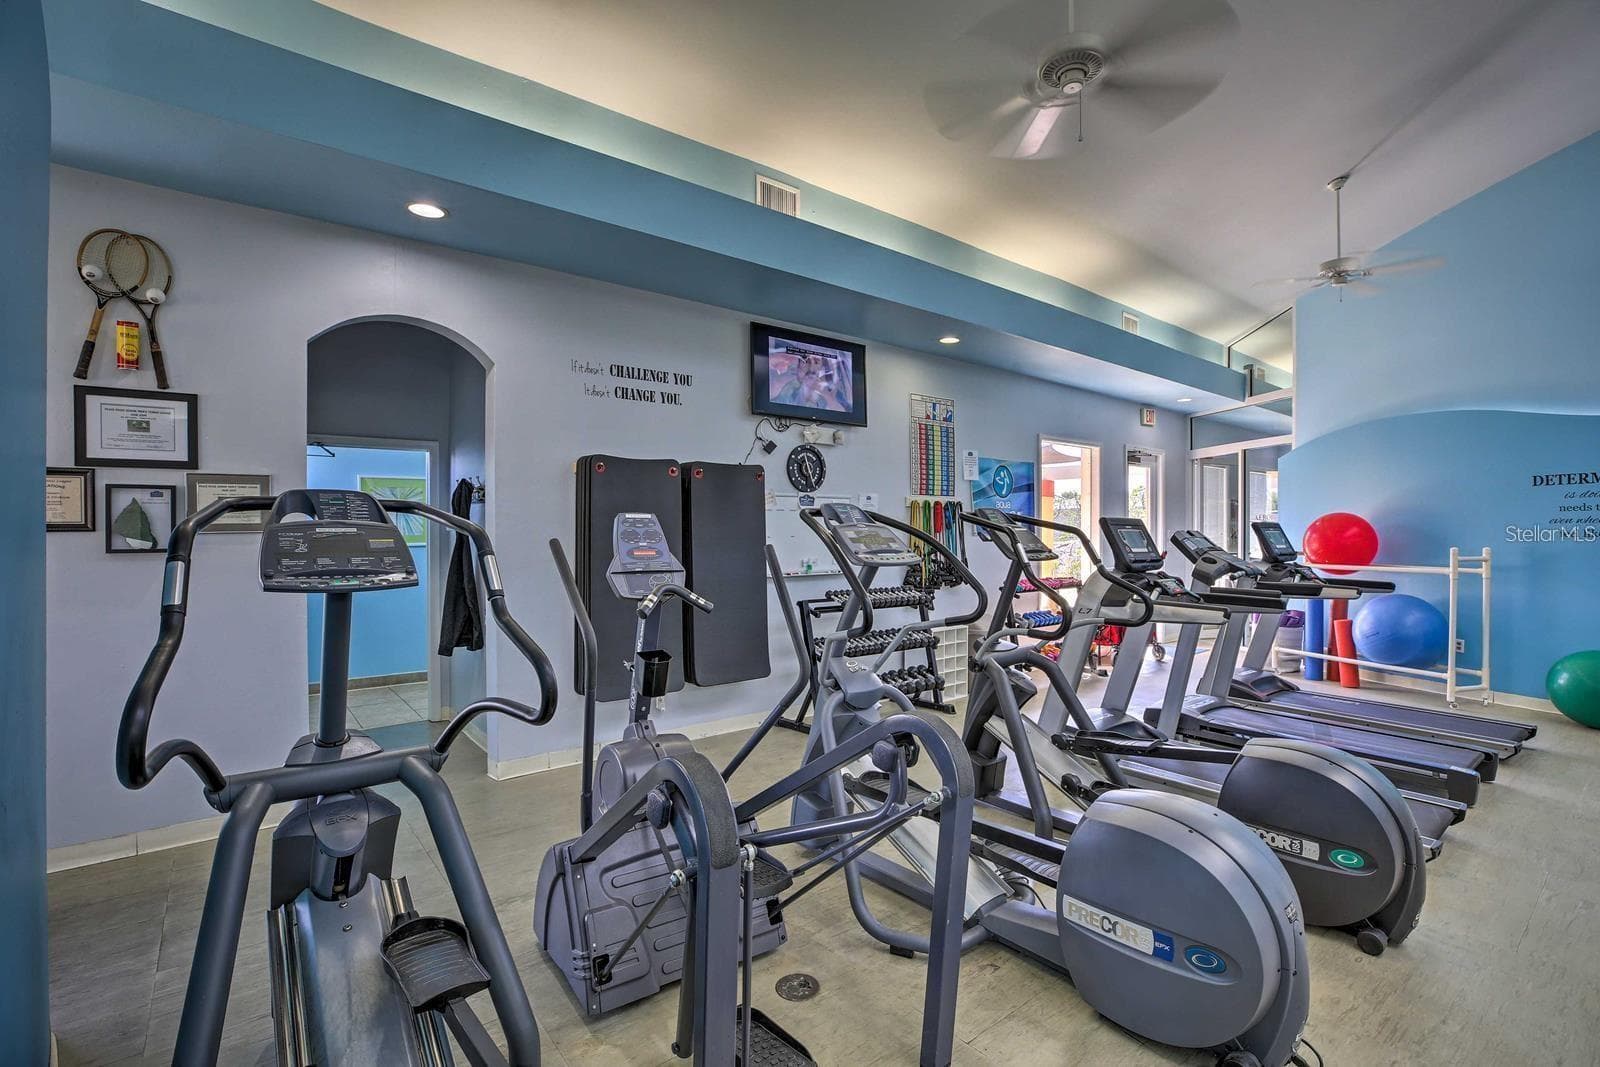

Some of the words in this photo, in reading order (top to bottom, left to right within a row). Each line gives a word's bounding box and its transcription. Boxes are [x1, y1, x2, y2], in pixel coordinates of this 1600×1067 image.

[609, 364, 669, 384] CHALLENGE
[673, 372, 693, 387] YOU
[614, 386, 656, 403] CHANGE
[660, 391, 683, 406] YOU.
[1564, 490, 1576, 499] is
[1559, 502, 1594, 512] needs
[1249, 827, 1291, 852] COR
[1067, 900, 1141, 946] PRECOR
